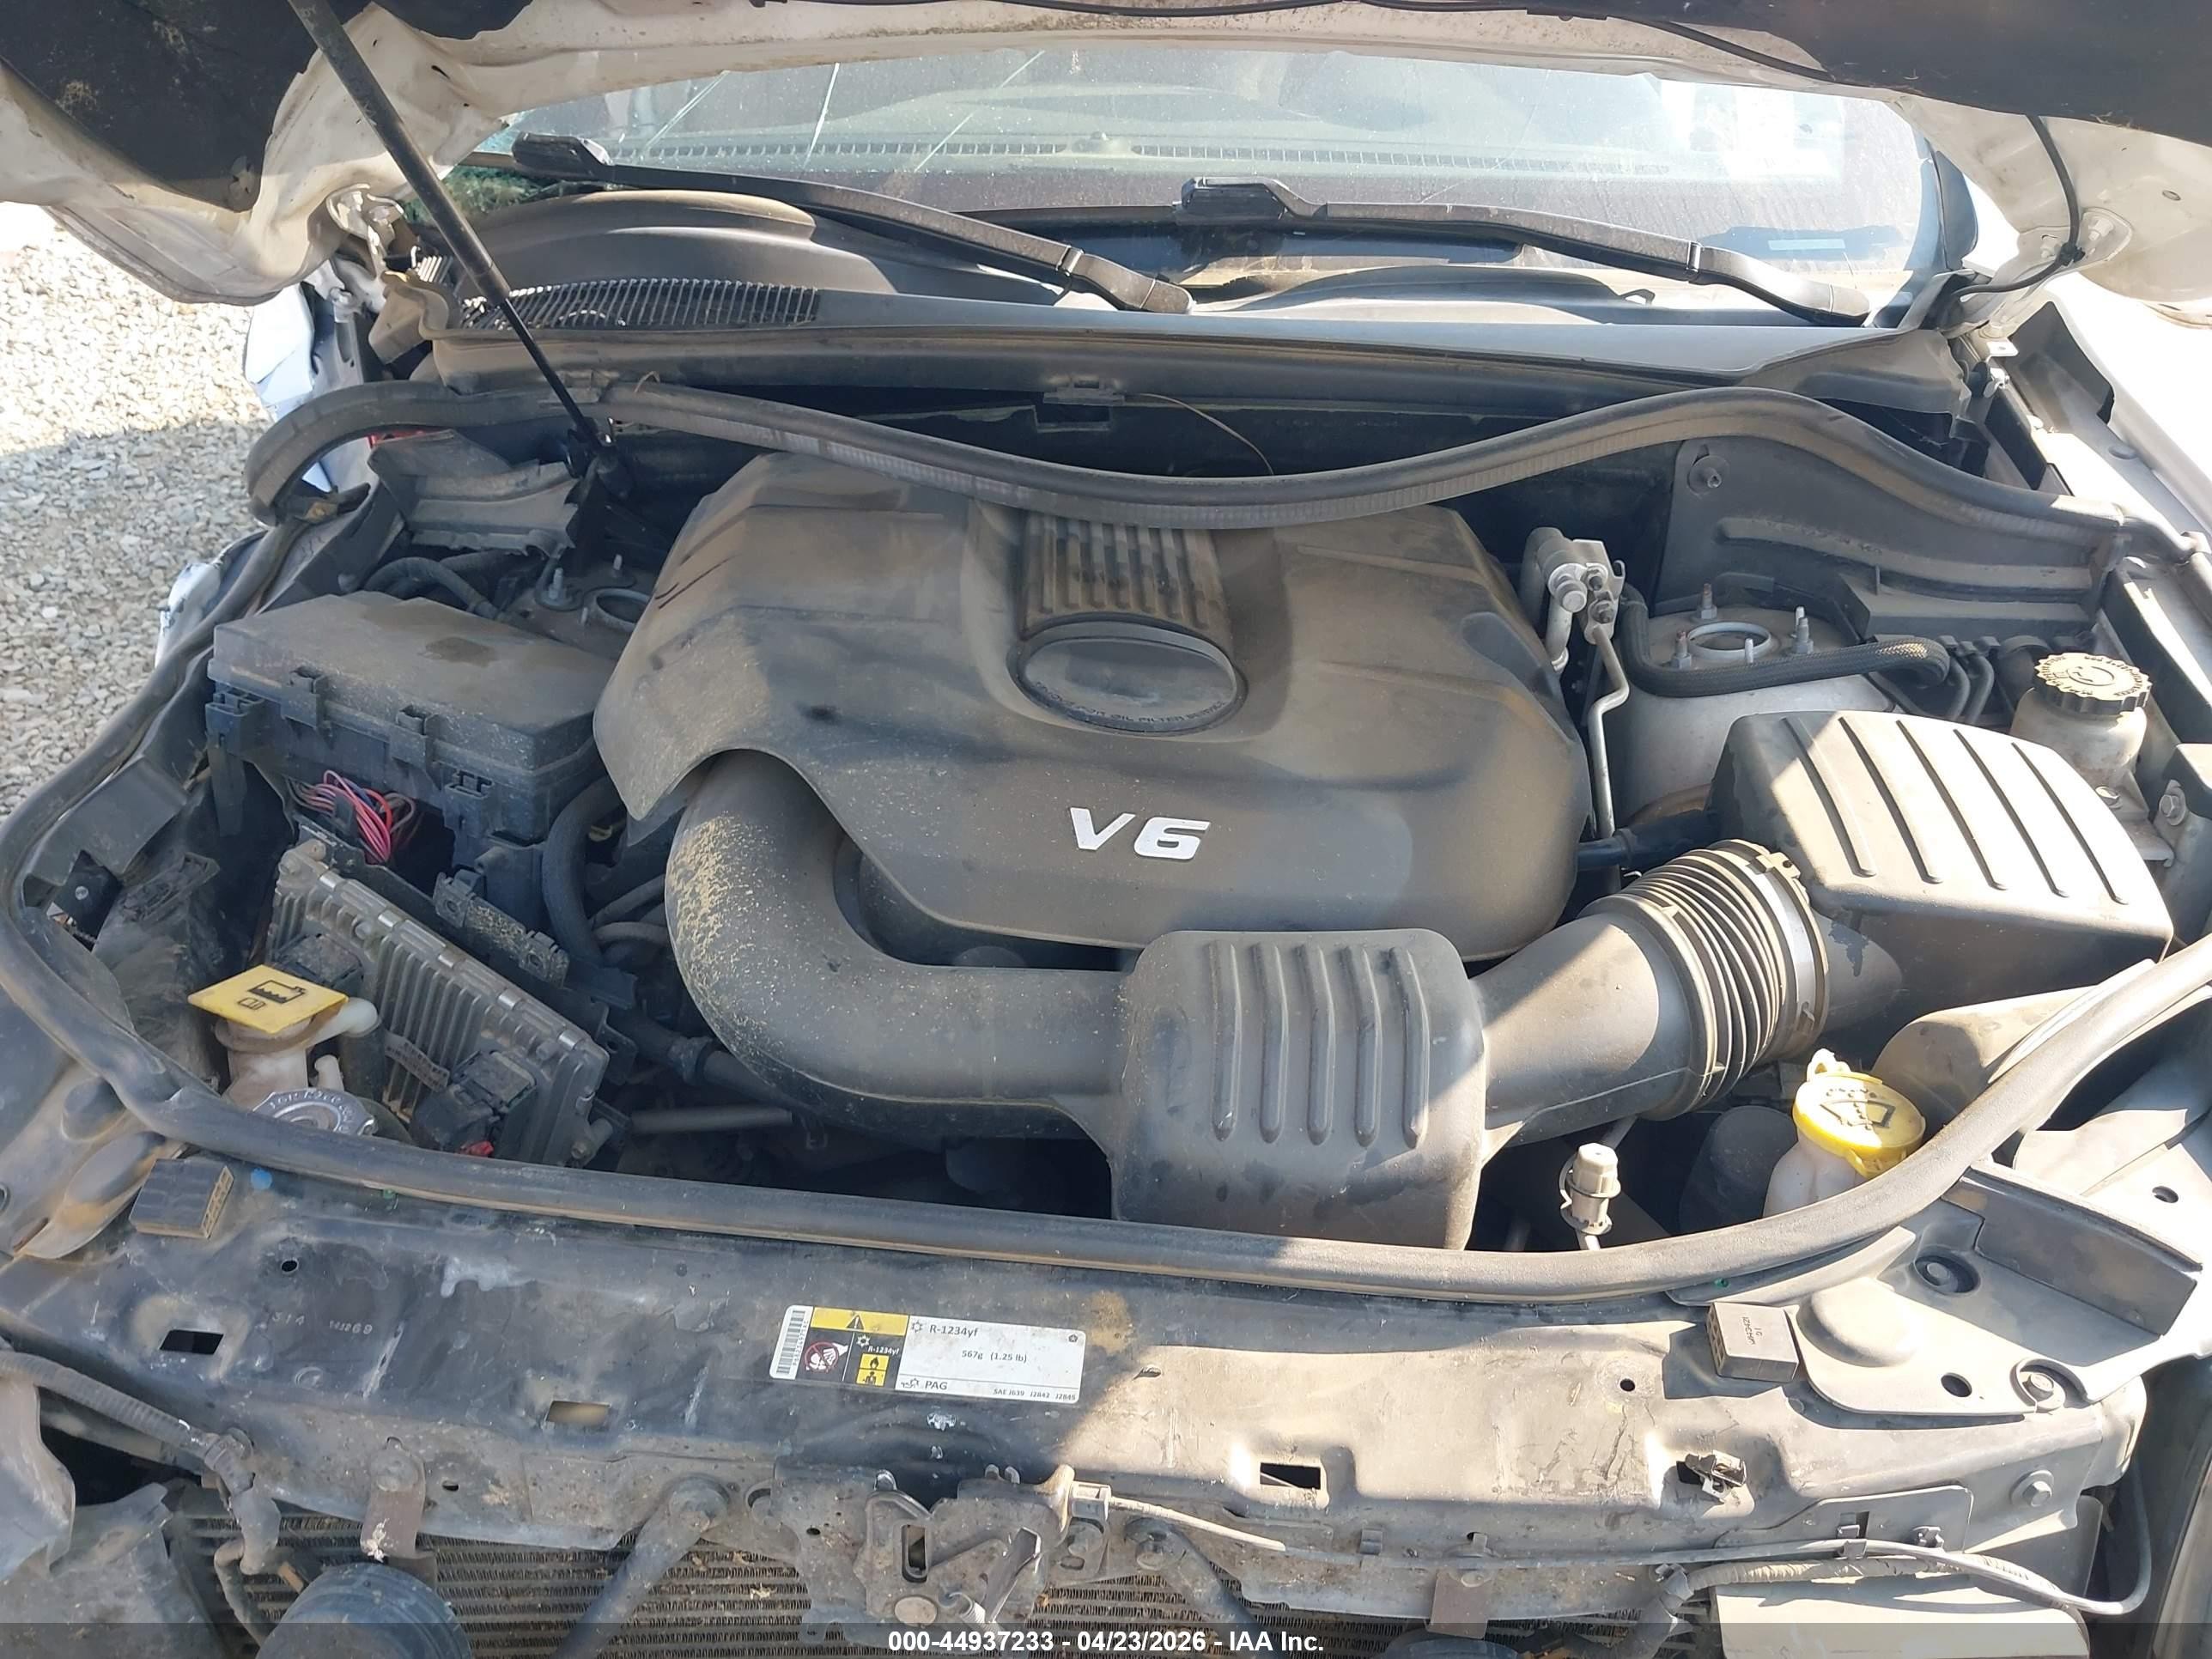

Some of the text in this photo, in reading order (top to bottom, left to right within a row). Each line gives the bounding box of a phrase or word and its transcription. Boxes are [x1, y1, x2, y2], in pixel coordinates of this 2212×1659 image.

[1070, 807, 1211, 860] V6
[929, 1324, 979, 1338] R-1234yf
[867, 1345, 900, 1357] R-1234yf
[962, 1349, 1027, 1364] 567g (1.25 lb)
[925, 1380, 948, 1390] PAG
